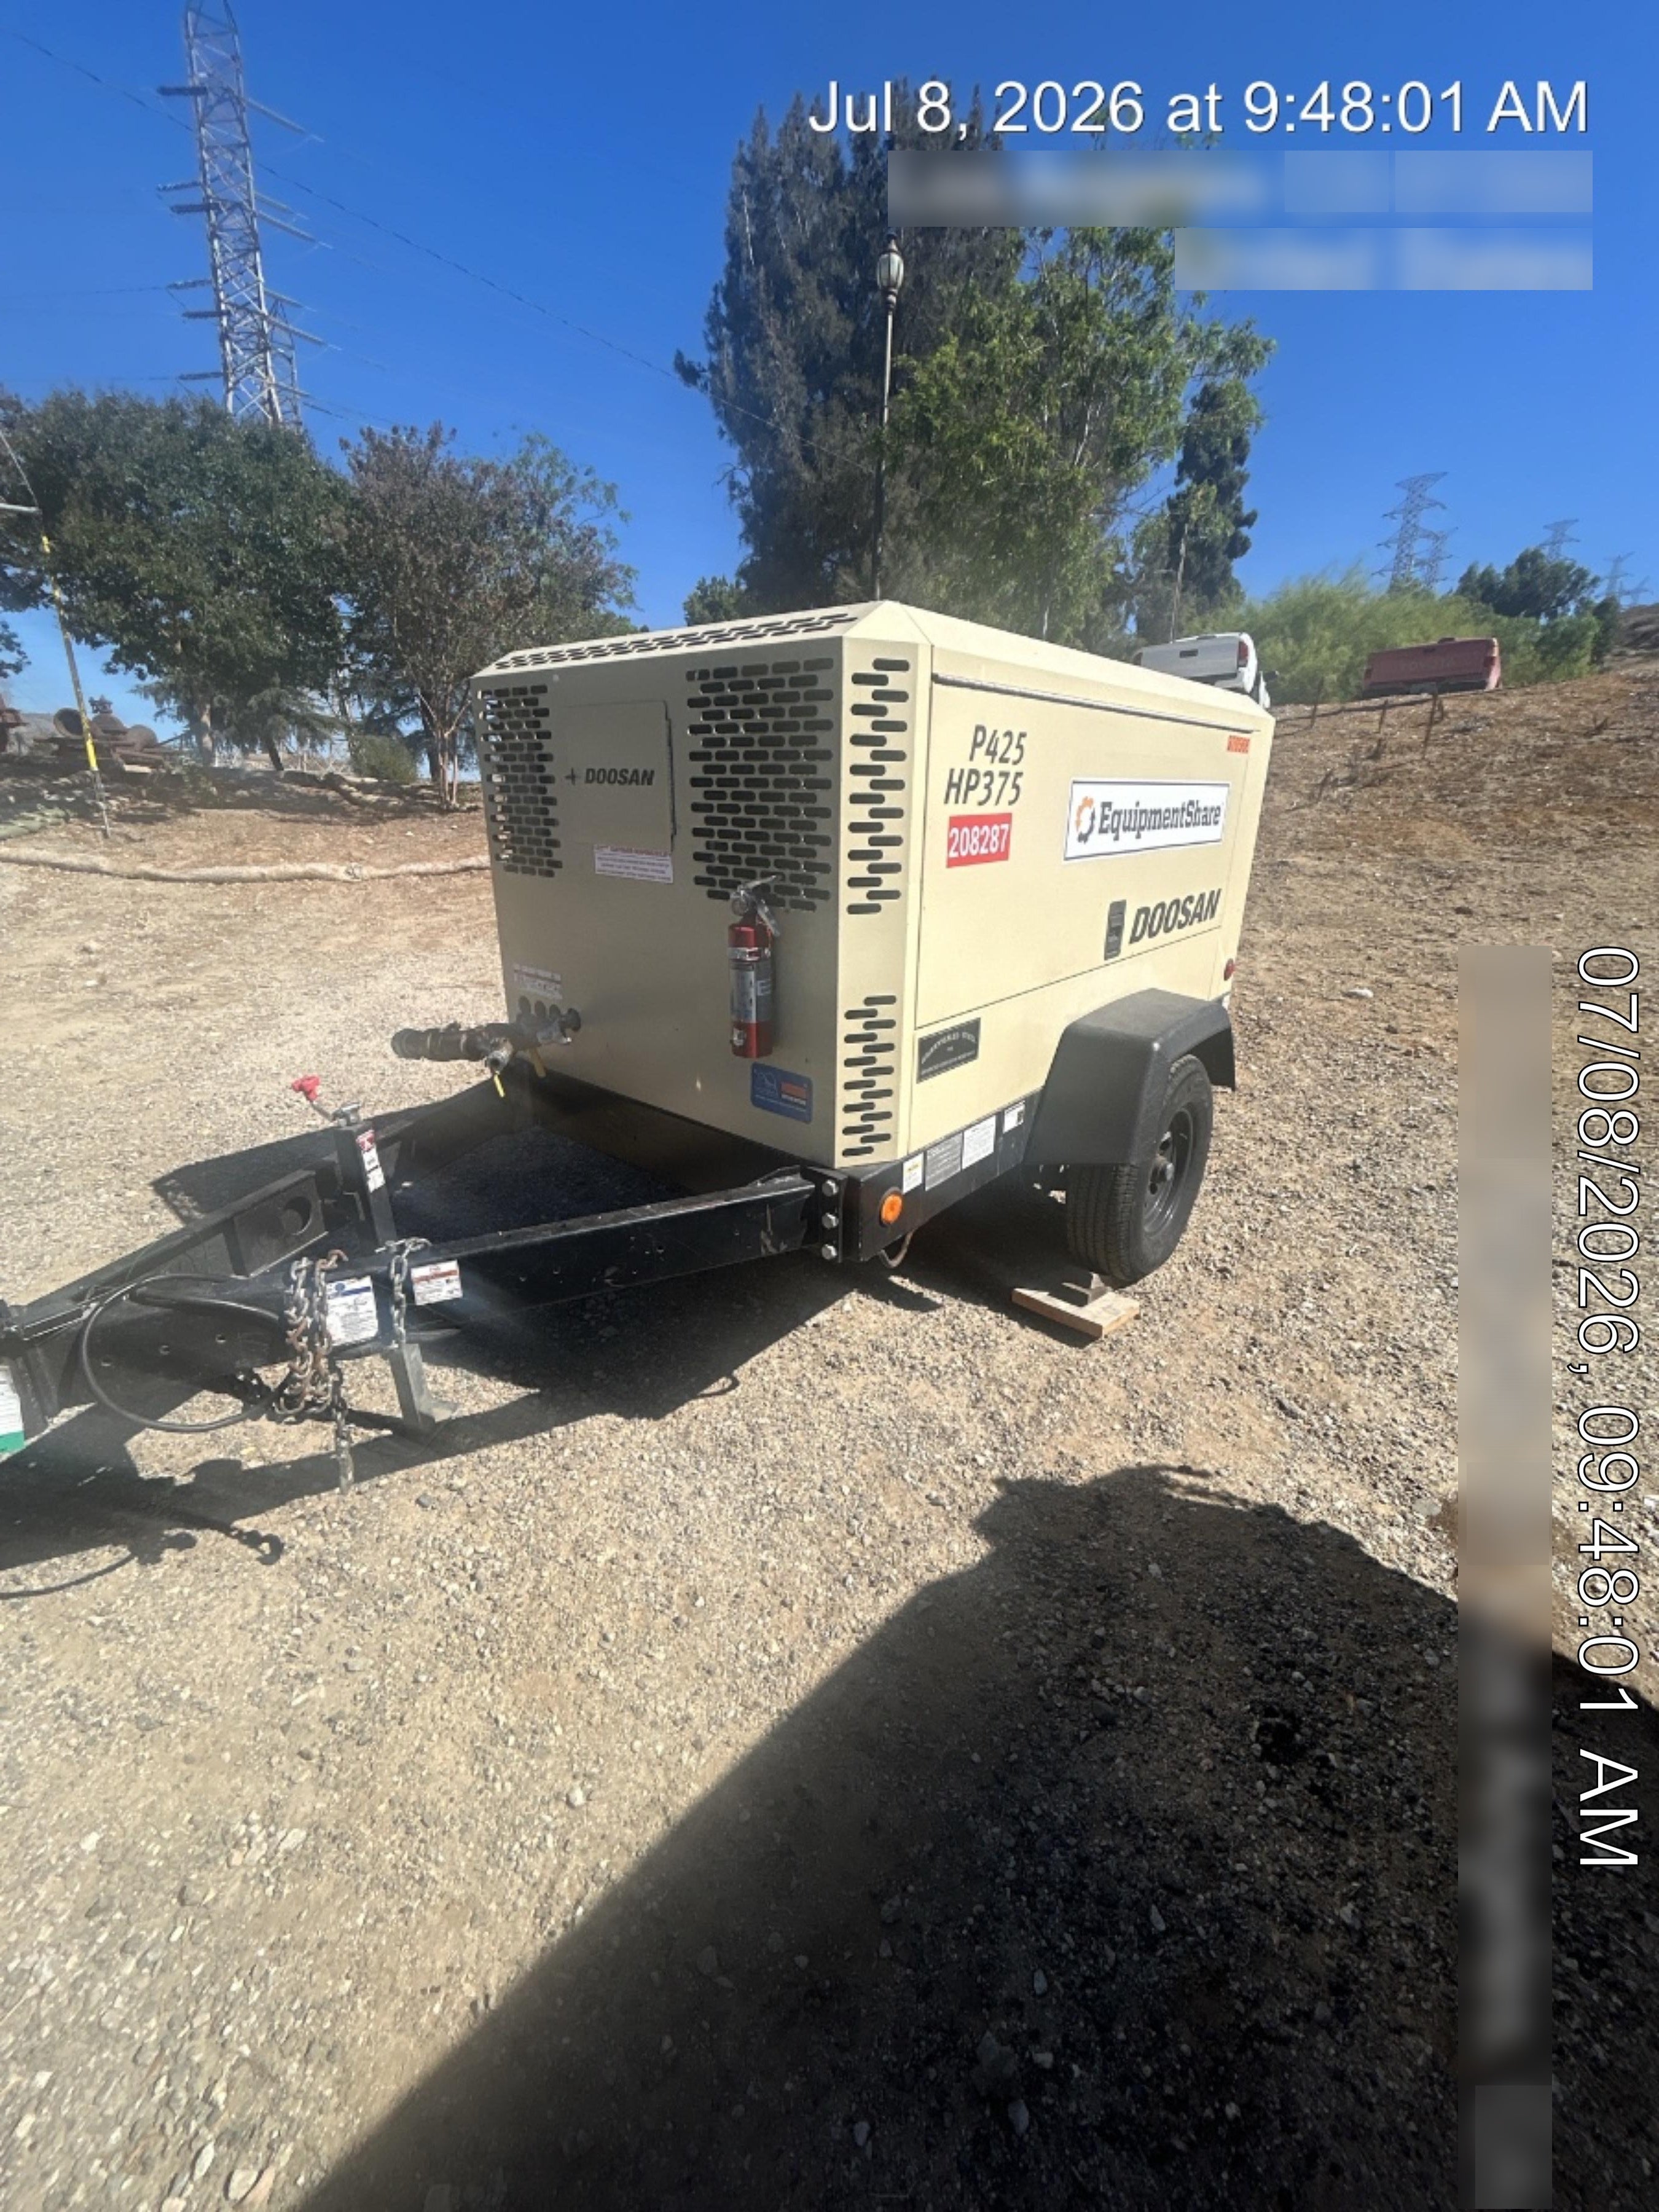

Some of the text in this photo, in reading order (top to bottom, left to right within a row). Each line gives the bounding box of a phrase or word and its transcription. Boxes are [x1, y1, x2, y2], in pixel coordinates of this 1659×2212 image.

[969, 724, 1027, 765] P425
[585, 768, 655, 786] DOOSAN
[944, 768, 1024, 806] HP375
[1098, 800, 1222, 841] EquipmentShare
[949, 823, 1010, 858] 208287
[1129, 888, 1222, 944] DOOSAN
